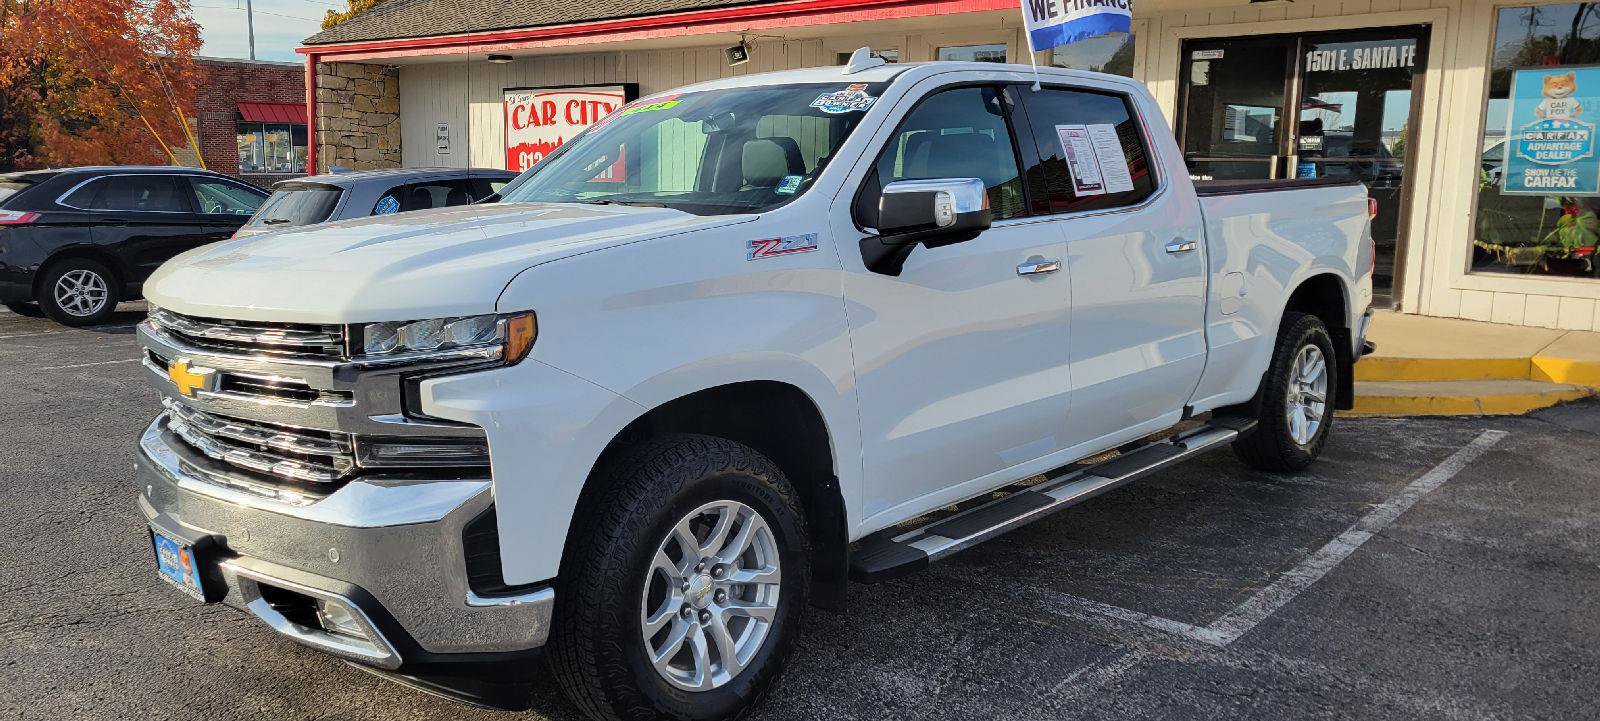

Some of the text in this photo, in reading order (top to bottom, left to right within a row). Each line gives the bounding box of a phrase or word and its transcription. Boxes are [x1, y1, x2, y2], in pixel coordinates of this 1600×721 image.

[1028, 0, 1058, 22] WE
[1305, 45, 1416, 72] 1501 E. SANTA FE
[512, 100, 557, 131] CAR
[564, 99, 618, 126] CITY
[1525, 131, 1588, 141] CARFAX
[1527, 142, 1582, 150] ADVANTAGE
[1535, 151, 1572, 159] DEALER
[1525, 177, 1576, 187] CARFAX
